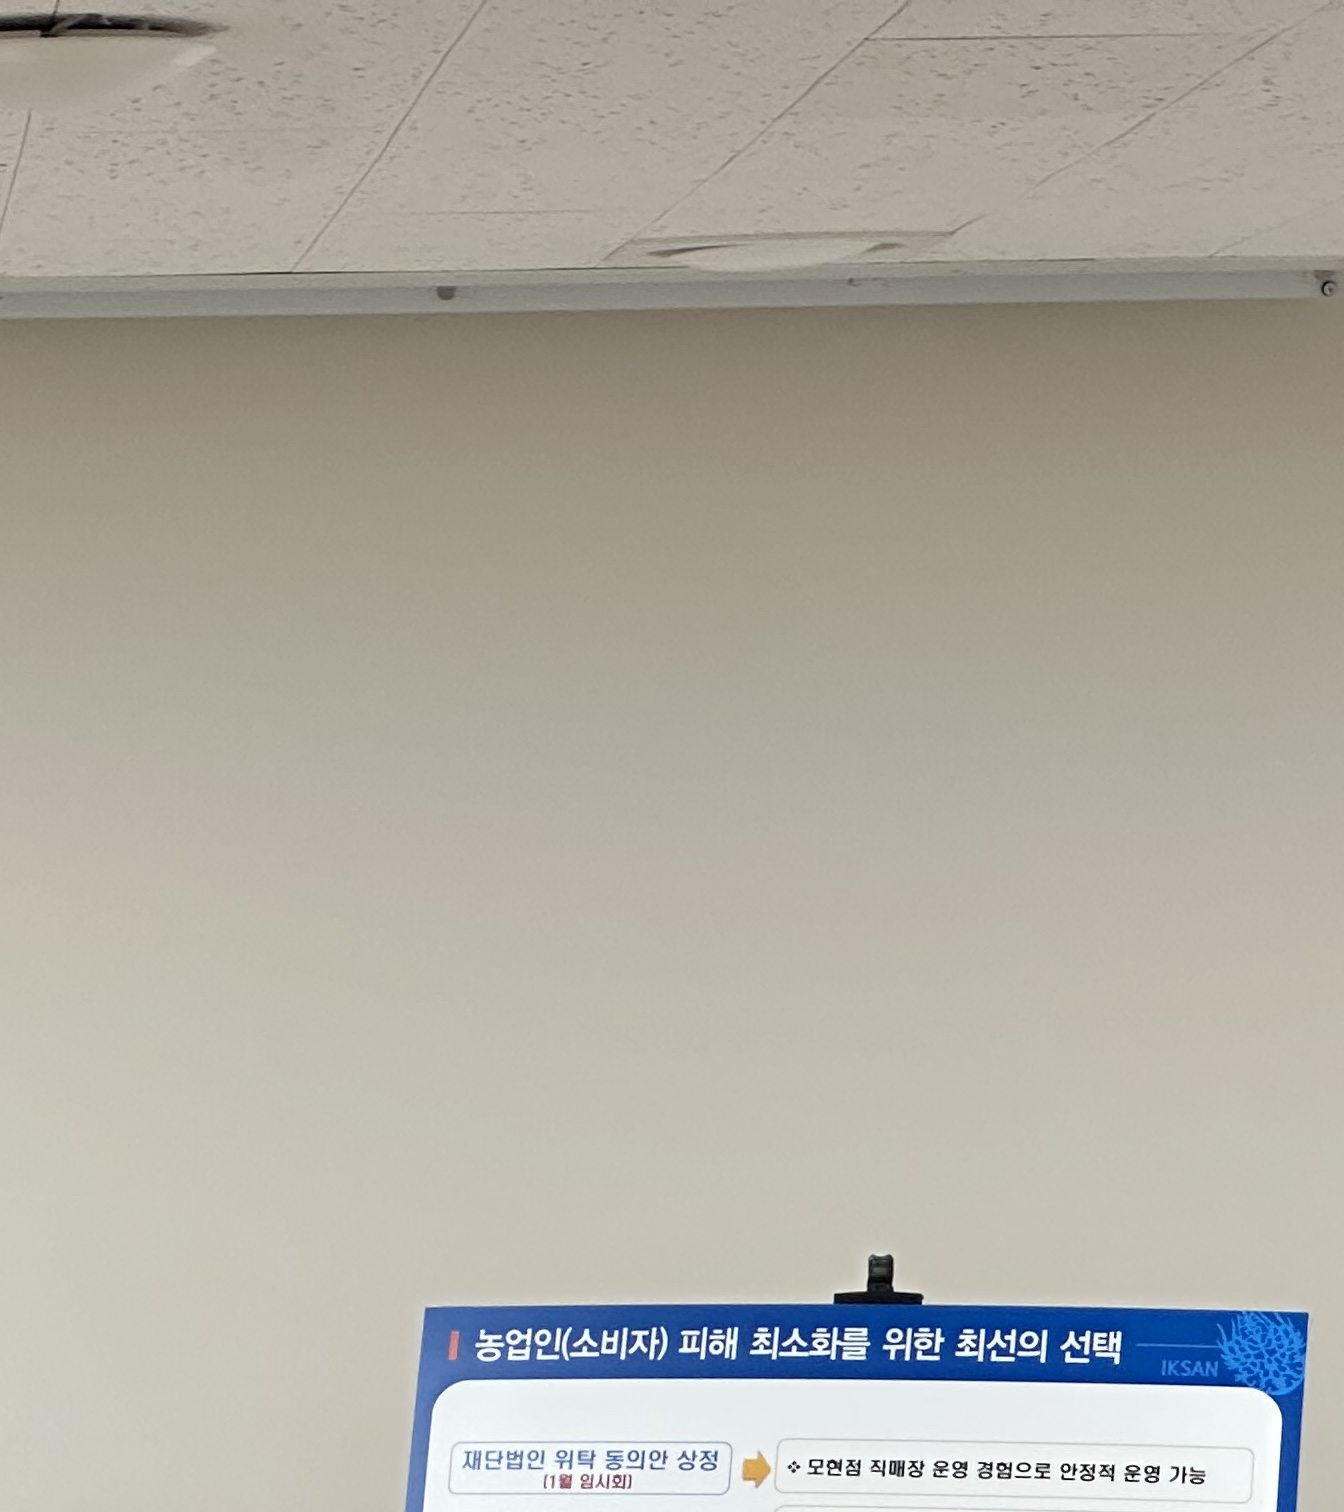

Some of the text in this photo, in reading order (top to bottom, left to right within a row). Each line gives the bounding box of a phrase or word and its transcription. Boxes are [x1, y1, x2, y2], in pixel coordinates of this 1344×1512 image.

[678, 1327, 739, 1360] 피해
[749, 1327, 871, 1361] 최소화를
[882, 1327, 945, 1361] 위한
[954, 1328, 1048, 1363] 최선의
[1059, 1330, 1122, 1365] 선택
[1161, 1359, 1219, 1377] IKSAN
[462, 1449, 719, 1474] 재단법인 위탁 동의안 상정
[807, 1458, 1206, 1485] 모현점 직매장 운영 경험으로 안정적 운영 가능
